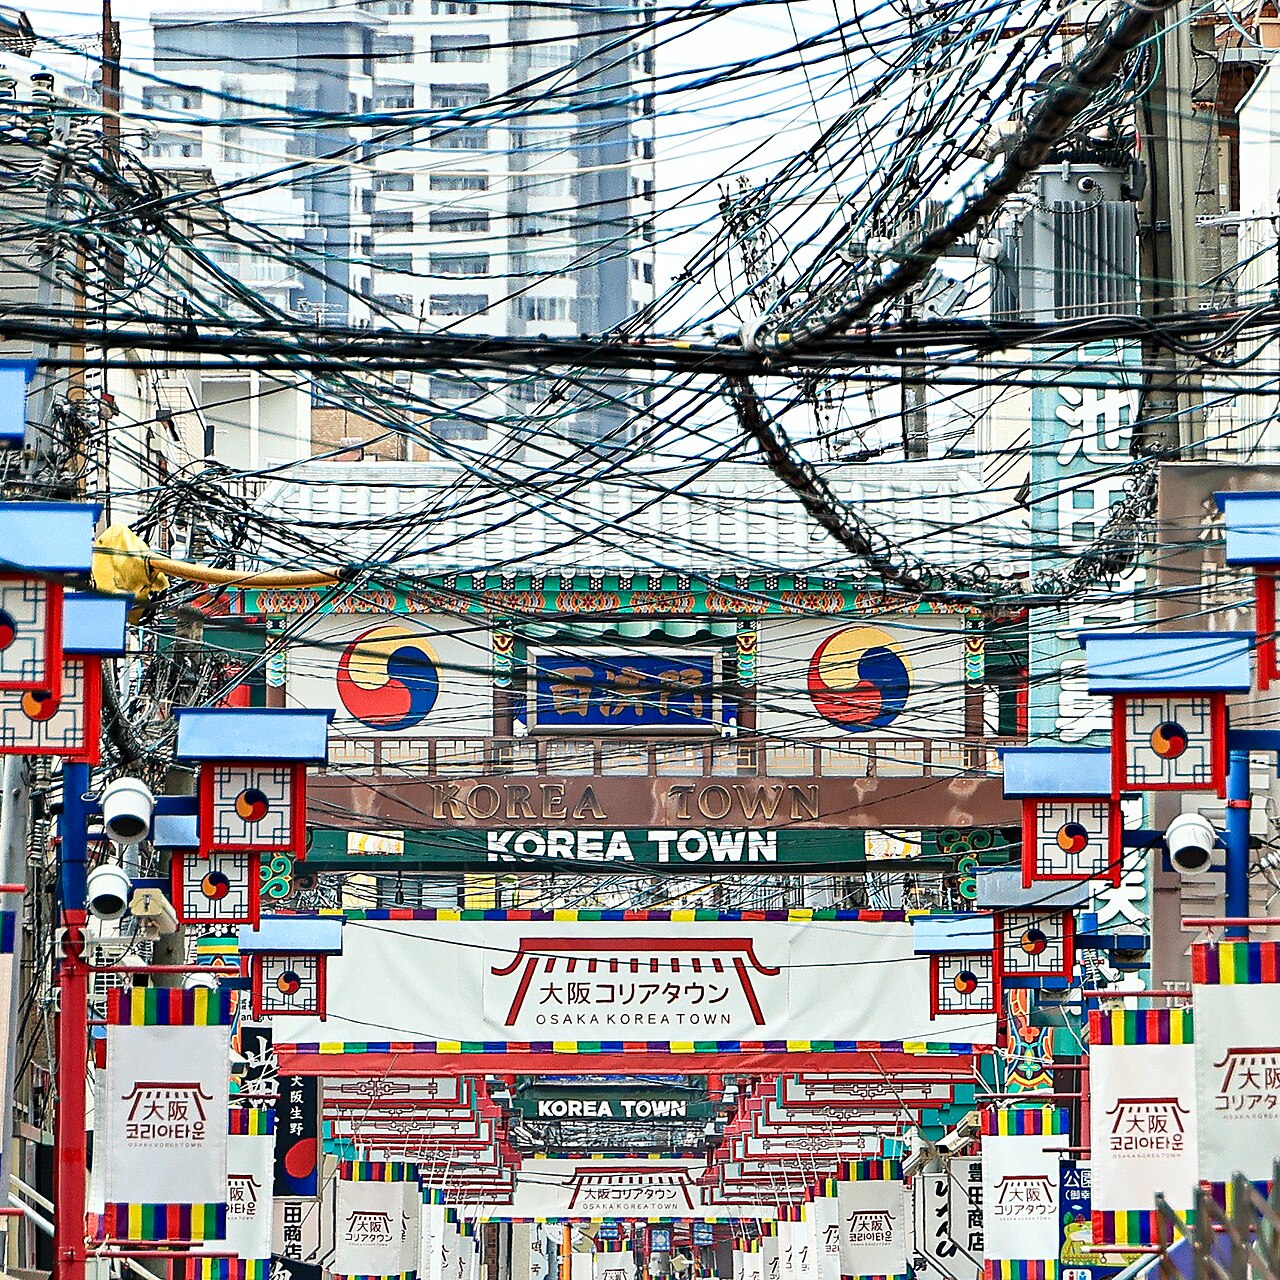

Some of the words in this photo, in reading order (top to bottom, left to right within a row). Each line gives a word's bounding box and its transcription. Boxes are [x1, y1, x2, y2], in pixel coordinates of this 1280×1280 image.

[432, 783, 608, 820] KOREA
[668, 784, 820, 820] TOWN
[487, 830, 634, 862] KOREA
[648, 830, 777, 862] TOWN
[539, 981, 730, 1005] 大阪コリアタウン
[536, 1013, 600, 1024] OSAKA
[607, 1013, 670, 1024] KOREA
[676, 1013, 731, 1024] TOWN
[143, 1099, 188, 1120] 大阪
[289, 1075, 304, 1137] 大阪生野
[538, 1100, 613, 1117] KOREA
[620, 1100, 686, 1117] TOWN
[125, 1123, 205, 1140] 코리아타운
[1126, 1114, 1169, 1134] 大阪
[1109, 1133, 1184, 1151] 코리아타운
[584, 1187, 677, 1199] 大阪コリアタウン
[1009, 1189, 1040, 1202] 大阪
[994, 1204, 1057, 1216] コリアタウン
[284, 1202, 302, 1260] 田商店
[357, 1222, 382, 1232] 大阪
